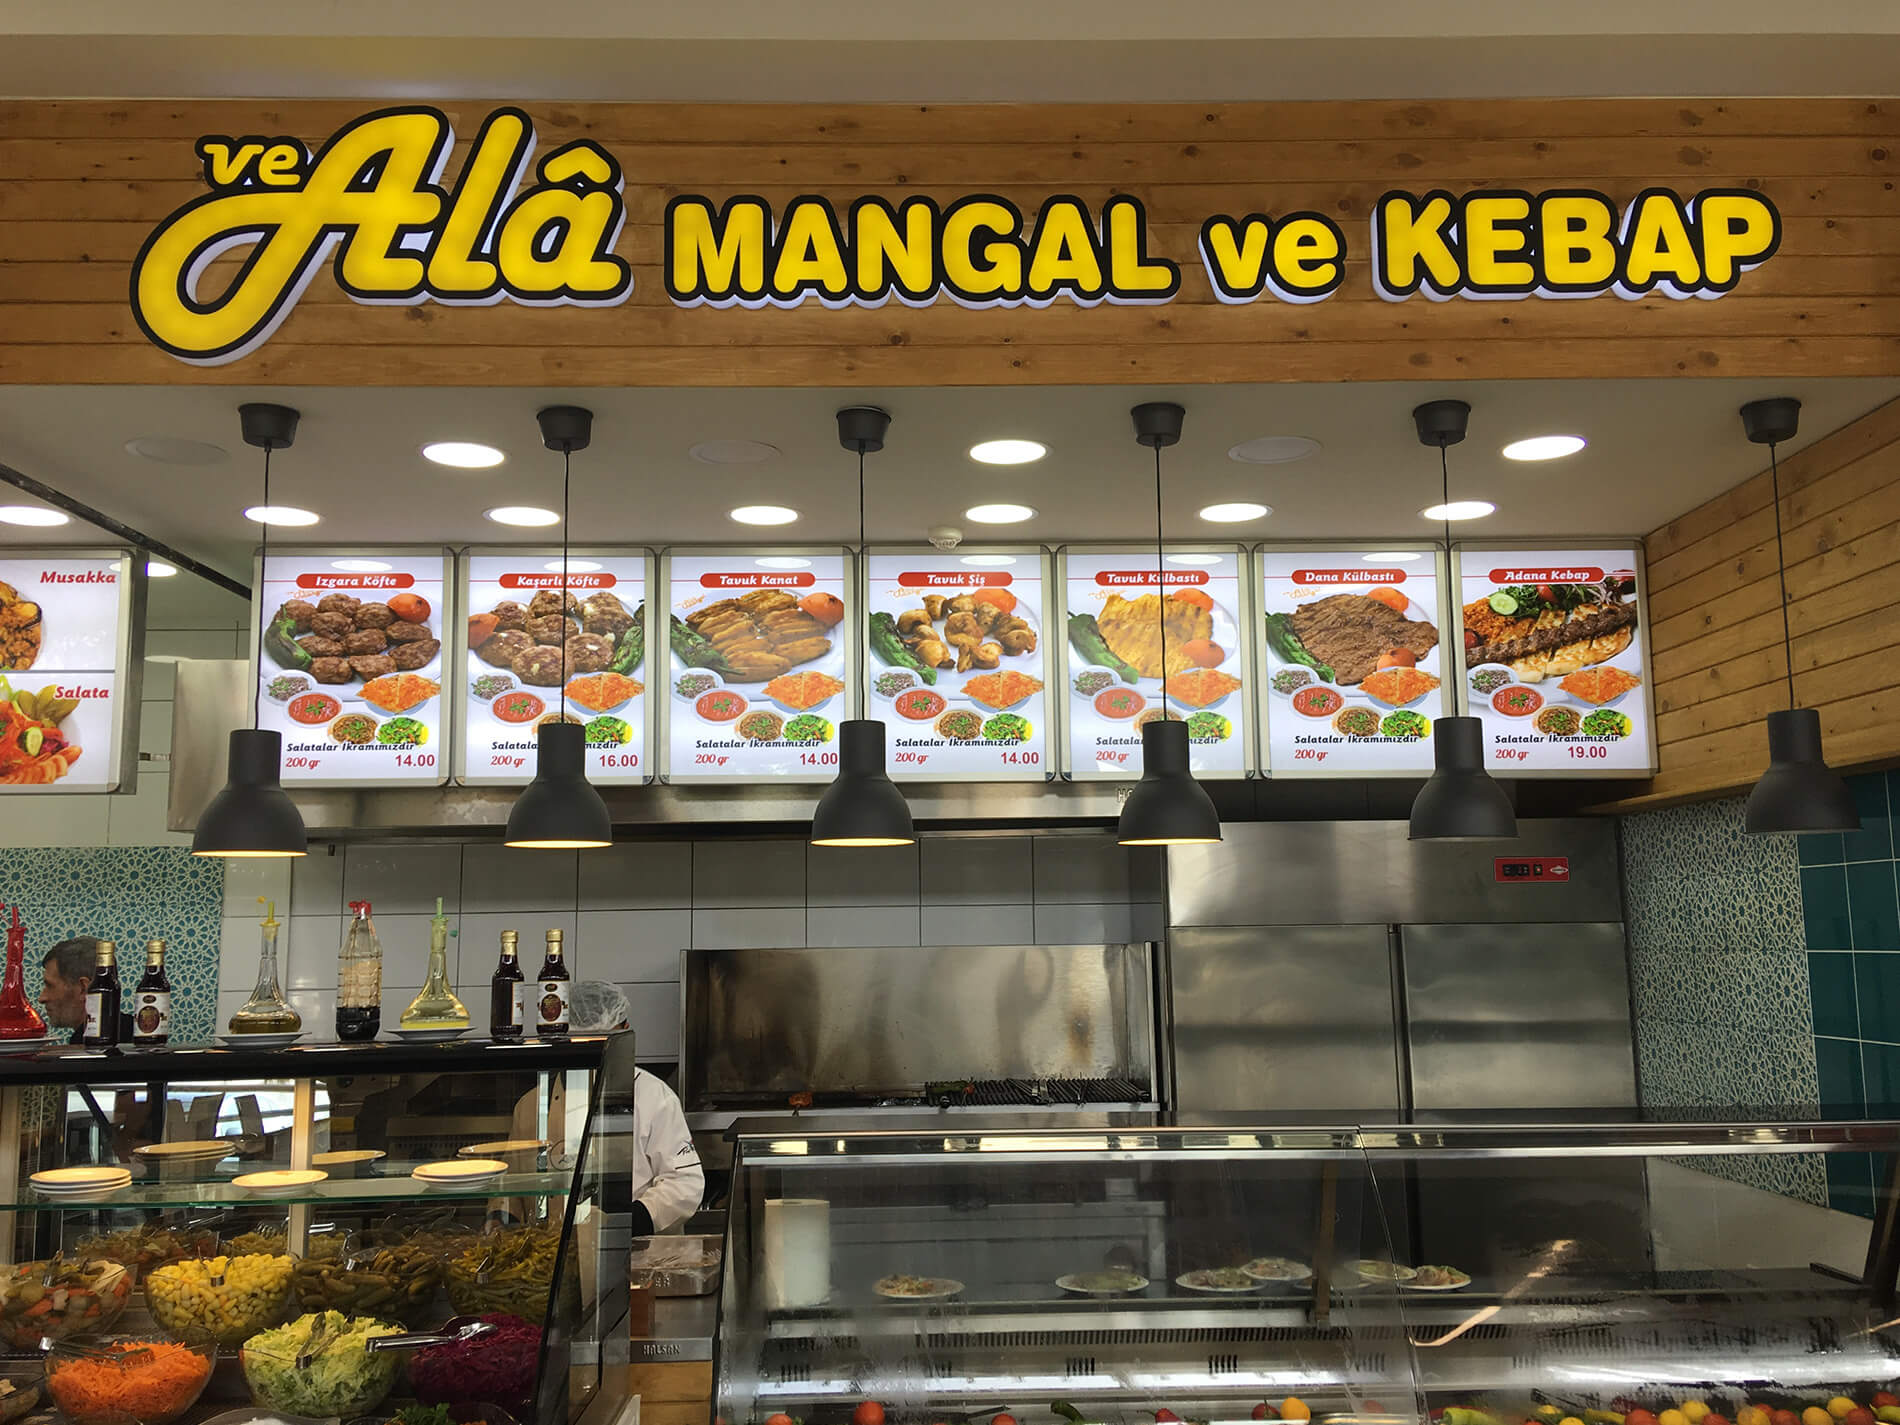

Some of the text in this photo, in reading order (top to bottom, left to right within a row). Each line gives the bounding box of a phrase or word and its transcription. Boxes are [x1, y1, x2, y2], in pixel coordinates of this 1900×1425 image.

[132, 108, 1779, 356] ve Alâ MANGAL ve KEBAP
[40, 571, 116, 583] Musakka
[363, 575, 397, 588] Köfte
[566, 575, 600, 588] Köfte
[720, 574, 798, 585] Tavuk Kanat
[927, 574, 964, 585] Tavuk
[1107, 573, 1144, 584] Tavuk
[1305, 571, 1394, 582] Dana Külbastı
[1504, 570, 1590, 582] Adana Kebap
[55, 686, 110, 699] Salata
[696, 740, 745, 748] Salatalar
[896, 738, 945, 747] Salatalar
[1295, 735, 1344, 744] Salatalar
[1495, 735, 1544, 743] Salatalar
[287, 743, 338, 752] Salatalar
[492, 741, 538, 750] Salatala
[895, 752, 928, 764] 200 gr
[1001, 752, 1039, 764] 14.00
[1096, 751, 1129, 762] 200 gr
[1295, 749, 1328, 761] 200 gr
[1495, 749, 1529, 760] 200 gr
[1568, 746, 1606, 758] 19.00
[286, 757, 320, 769] 200 gr
[395, 754, 435, 766] 14.00
[491, 755, 525, 768] 200 gr
[600, 754, 638, 767] 16.00
[695, 754, 729, 766] 200 gr
[800, 753, 838, 765] 14.00
